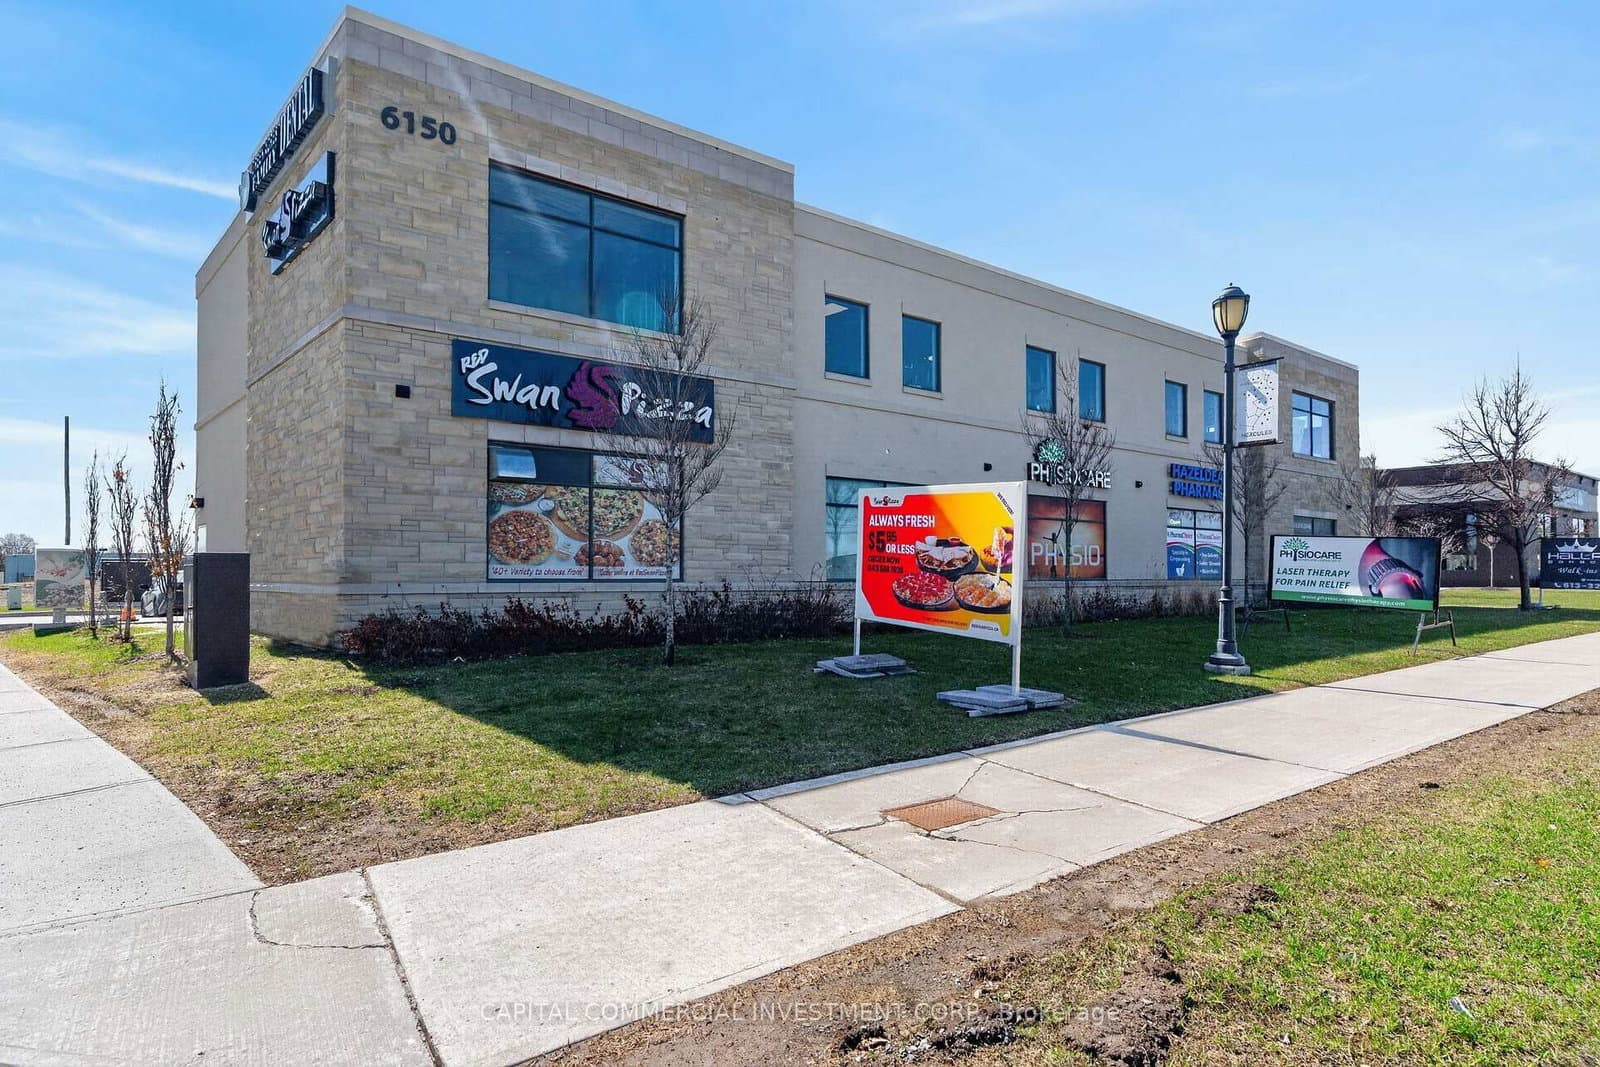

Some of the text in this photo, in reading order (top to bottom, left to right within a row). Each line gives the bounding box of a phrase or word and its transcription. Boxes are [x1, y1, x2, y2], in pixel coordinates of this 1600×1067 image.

[279, 66, 317, 157] DENTAL
[380, 106, 457, 145] 6150
[460, 348, 489, 373] RED
[466, 362, 713, 429] Swan Pizza
[1172, 463, 1224, 484] HAZELDEA
[868, 514, 936, 528] ALWAYS FRESH
[885, 543, 915, 555] OR LESS
[1279, 548, 1342, 562] PHYSIOCARE
[535, 567, 543, 576] to
[1277, 567, 1351, 578] LASER THERAPY
[1275, 577, 1351, 590] FOR PAIN RELIEF
